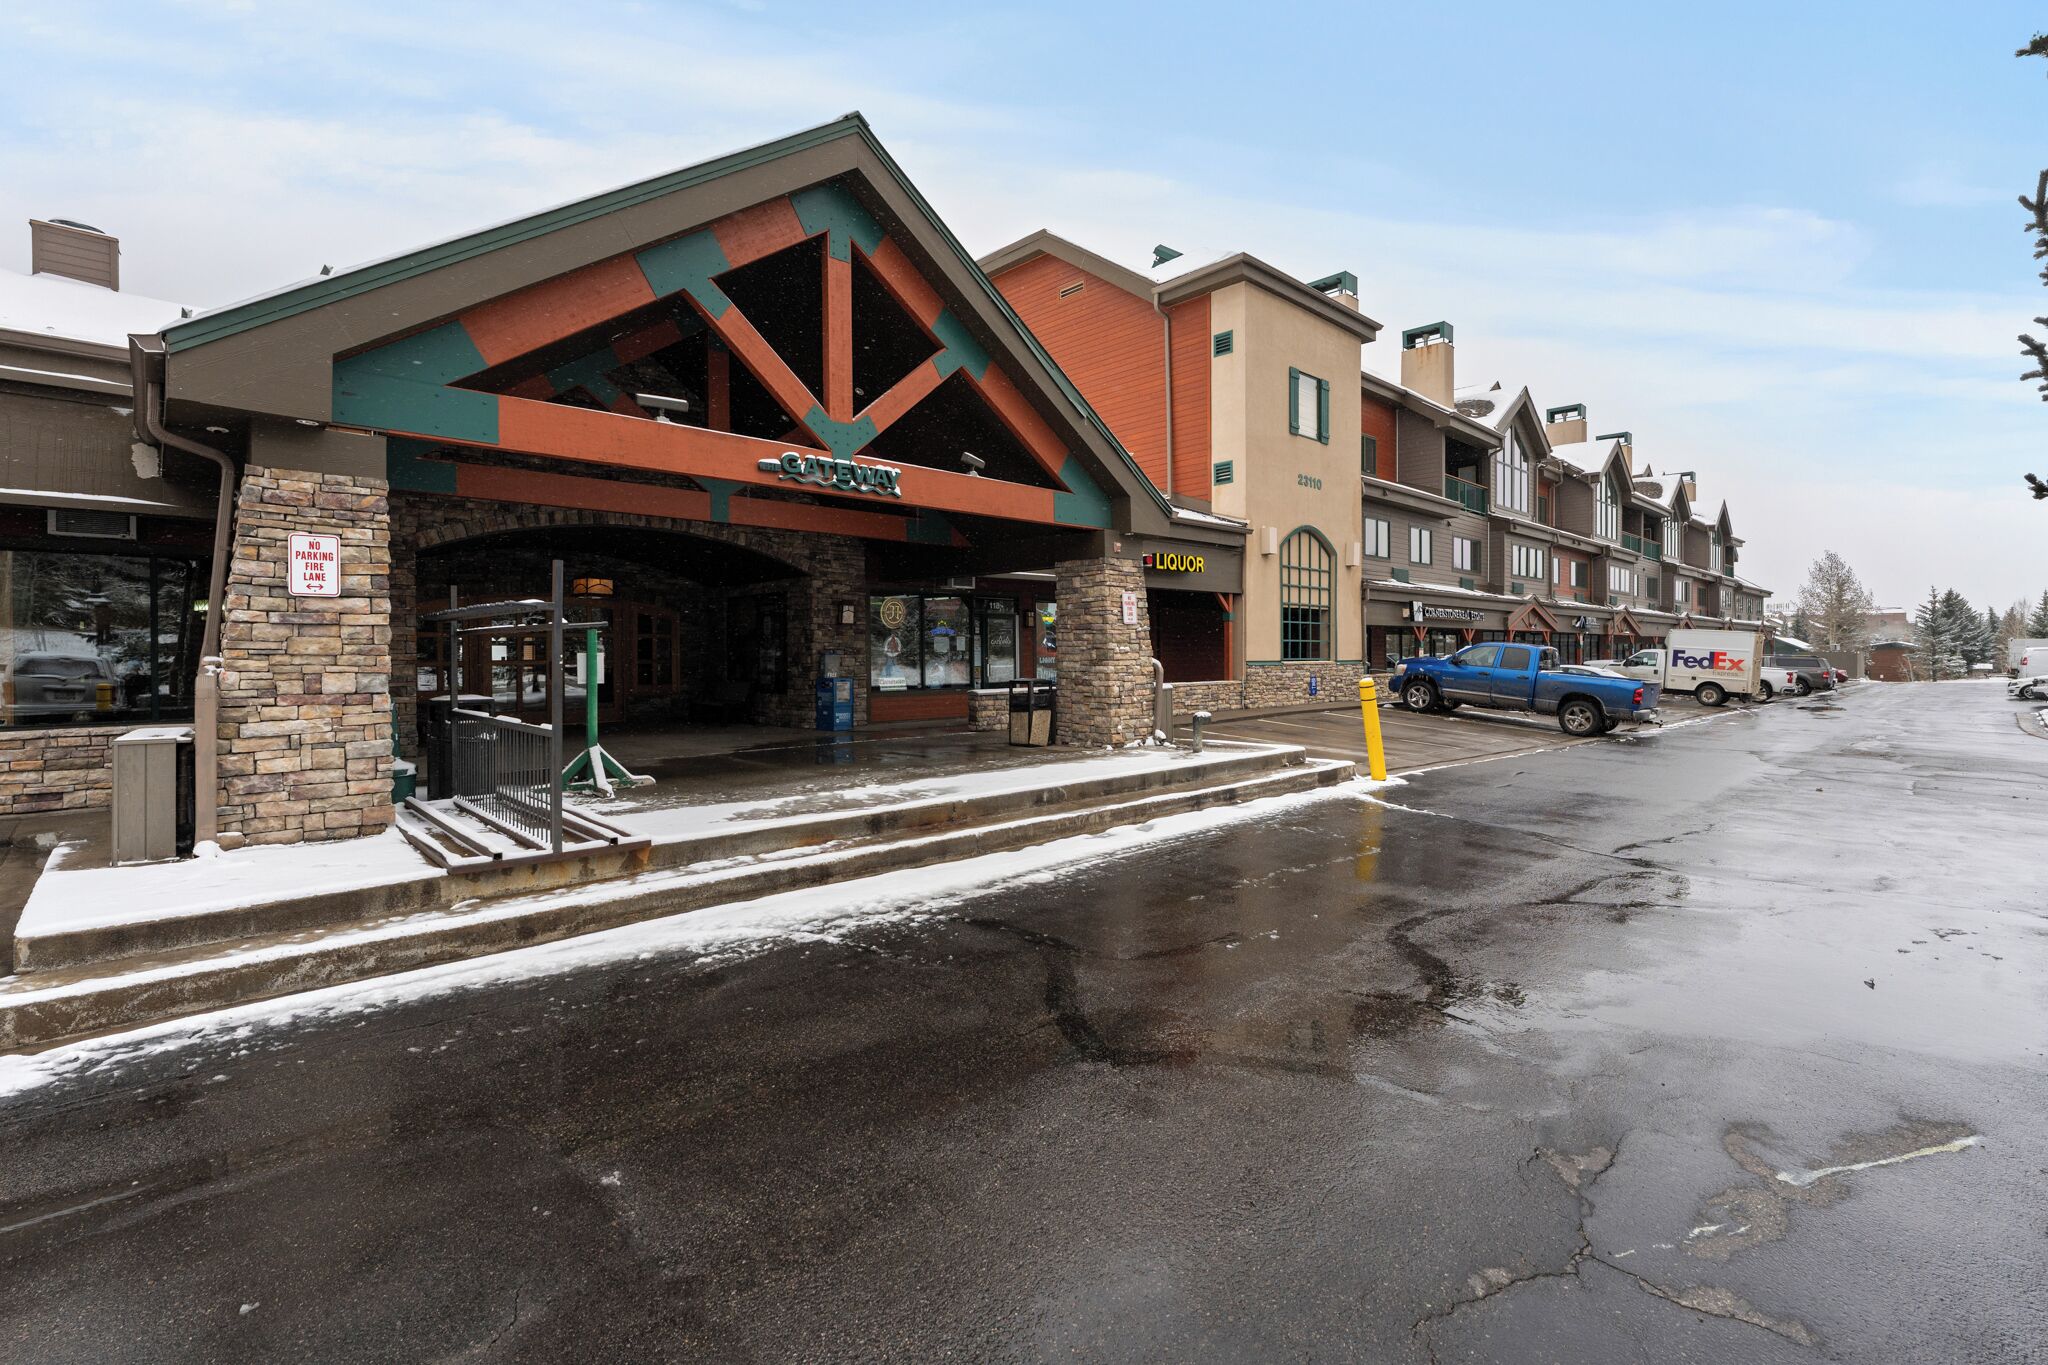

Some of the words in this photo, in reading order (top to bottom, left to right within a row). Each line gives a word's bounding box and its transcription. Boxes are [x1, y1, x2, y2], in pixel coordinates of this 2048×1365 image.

[781, 453, 901, 490] GATEWAY
[1298, 474, 1321, 490] 23110
[309, 541, 320, 550] NO
[295, 551, 333, 561] PARKING
[1156, 553, 1204, 572] LIQUOR
[305, 562, 324, 571] FIRE
[303, 572, 326, 581] LANE
[1672, 650, 1744, 671] FedEx
